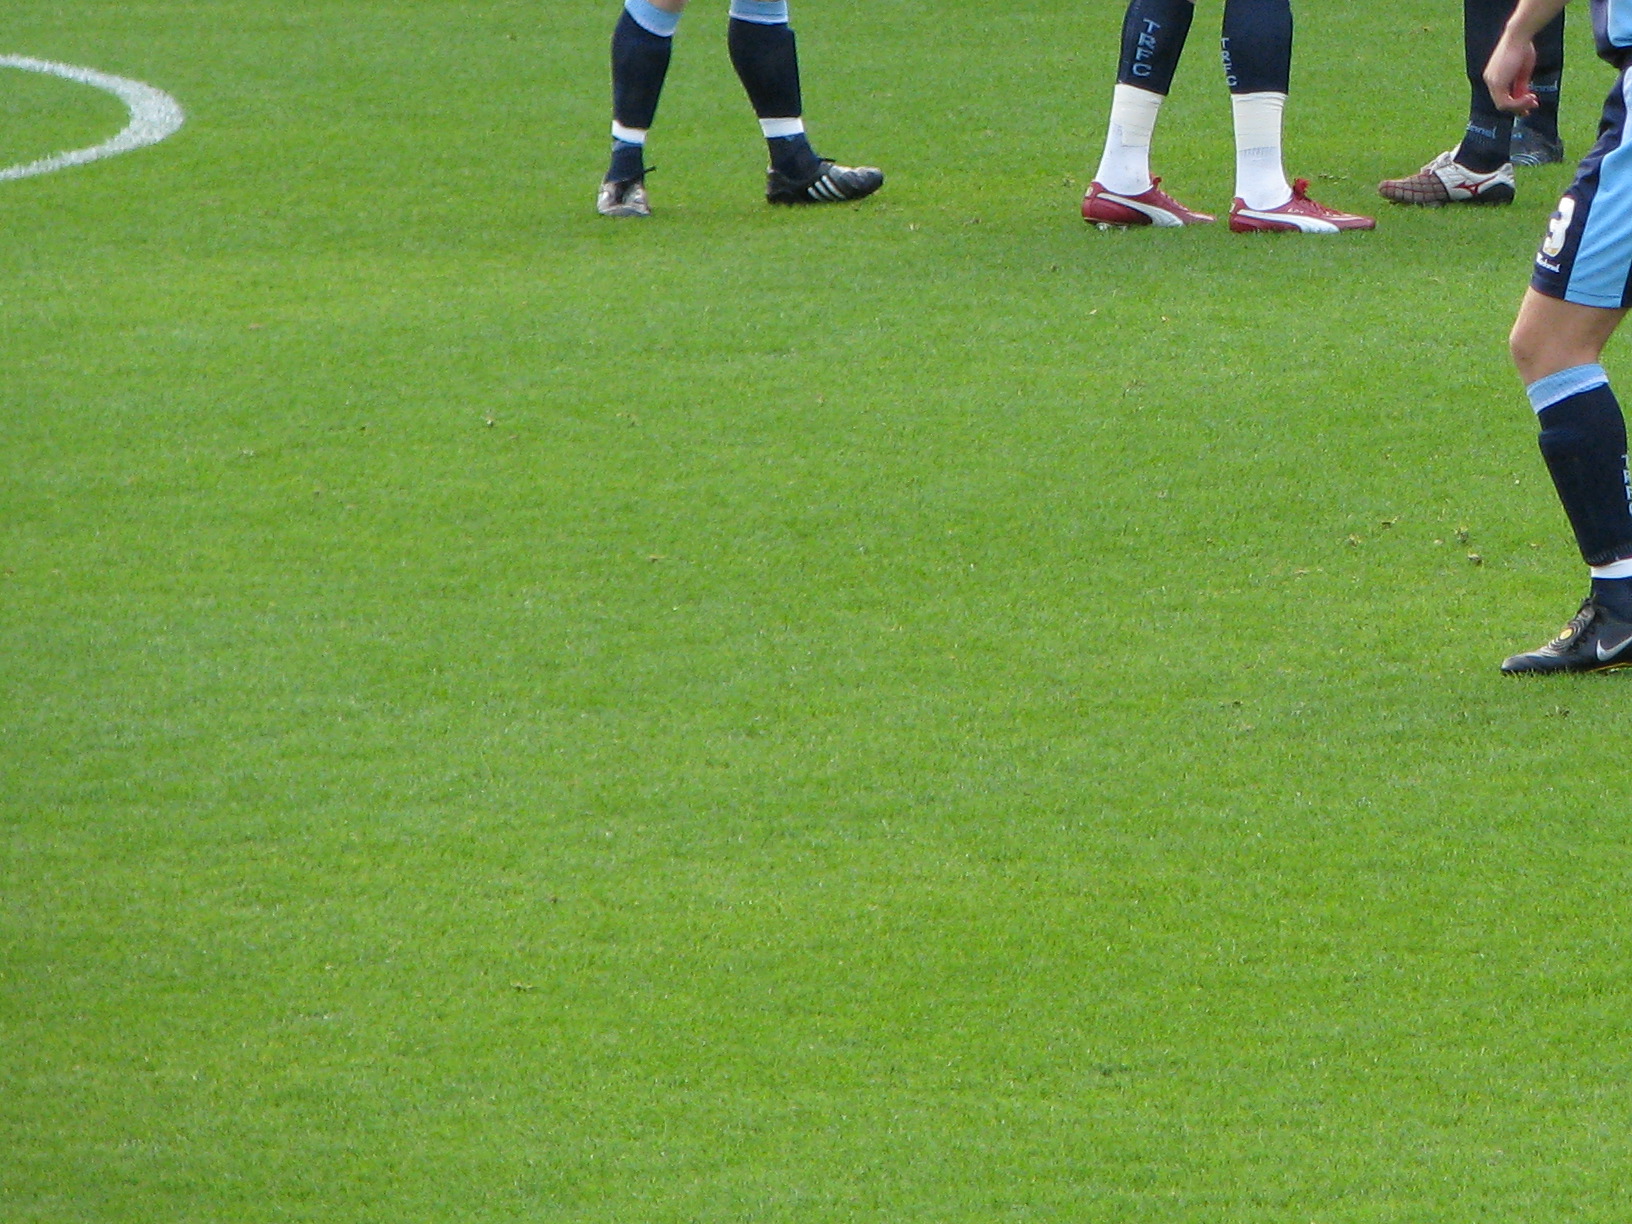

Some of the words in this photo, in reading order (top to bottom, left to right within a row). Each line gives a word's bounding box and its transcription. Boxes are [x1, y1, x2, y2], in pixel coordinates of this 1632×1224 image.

[1132, 17, 1161, 77] TRFC
[1220, 37, 1238, 87] TRFC
[1542, 196, 1576, 258] 3
